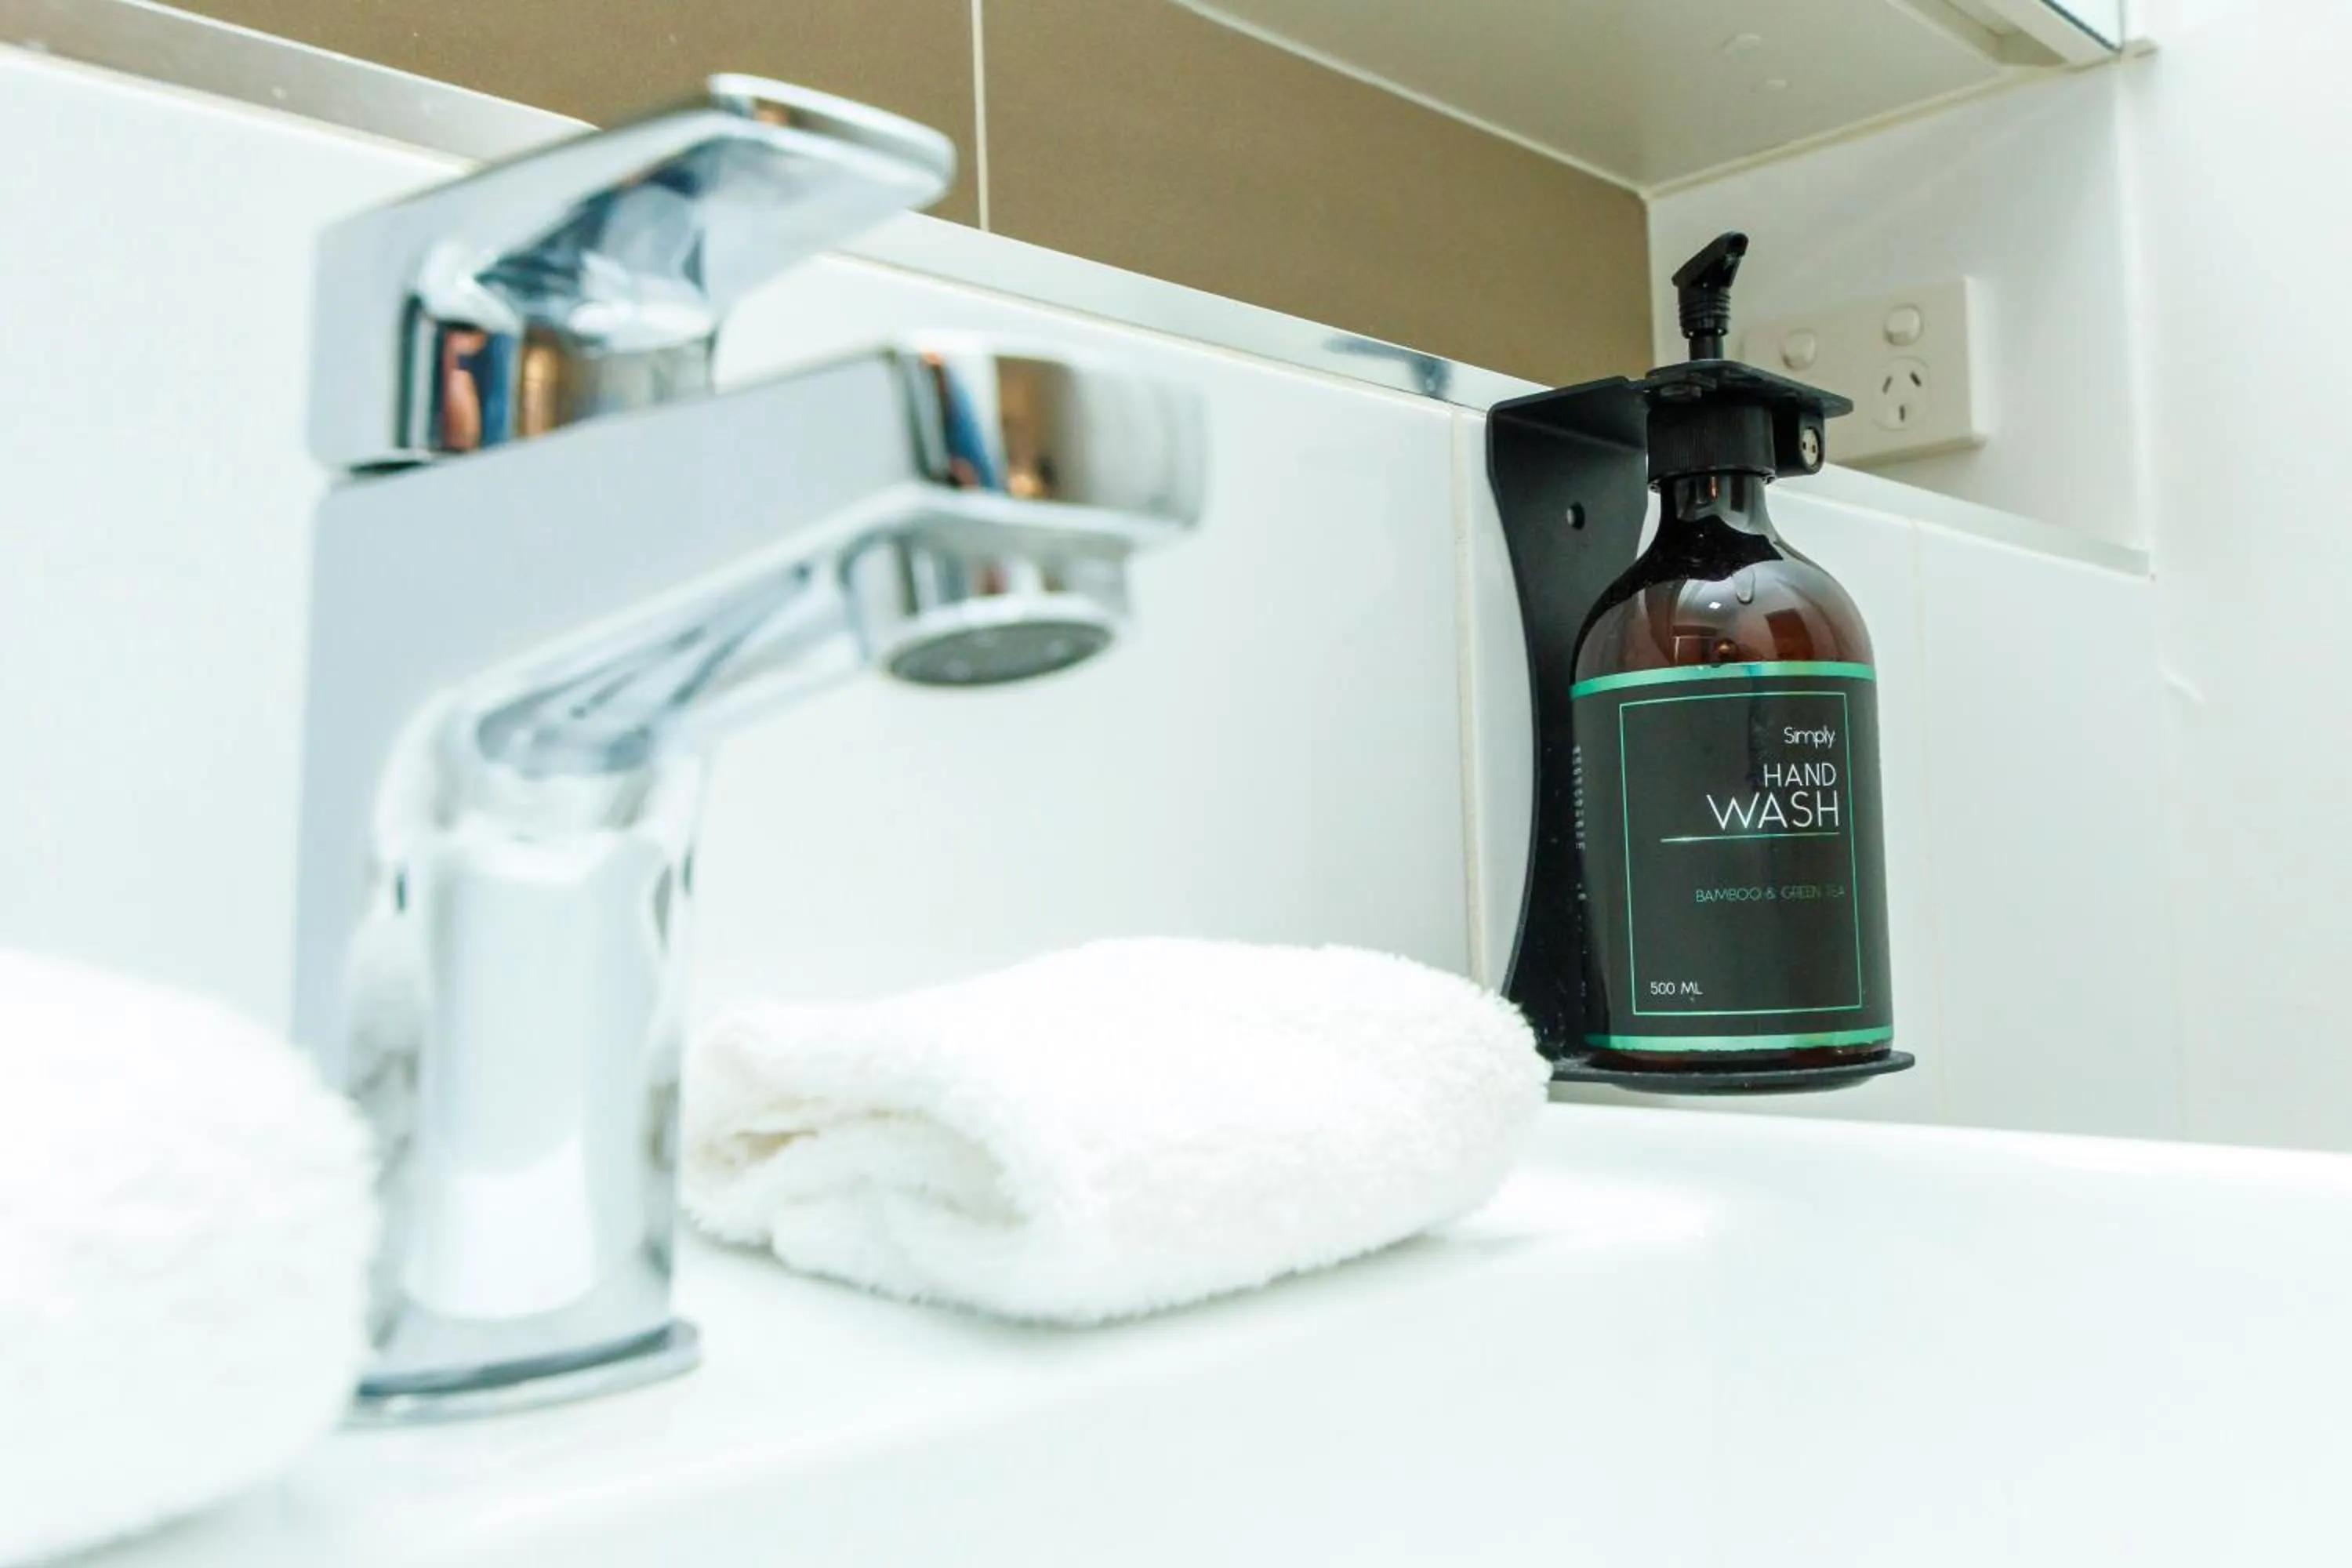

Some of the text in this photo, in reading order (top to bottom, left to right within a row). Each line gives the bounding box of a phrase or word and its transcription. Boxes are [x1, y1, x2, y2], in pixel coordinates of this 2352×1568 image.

[1784, 725, 1835, 749] Simply
[1763, 762, 1837, 787] HAND
[1707, 790, 1839, 829] WASH
[1695, 888, 1761, 902] BAMBOO
[1766, 888, 1776, 900] &
[1650, 981, 1703, 995] 500 ML
